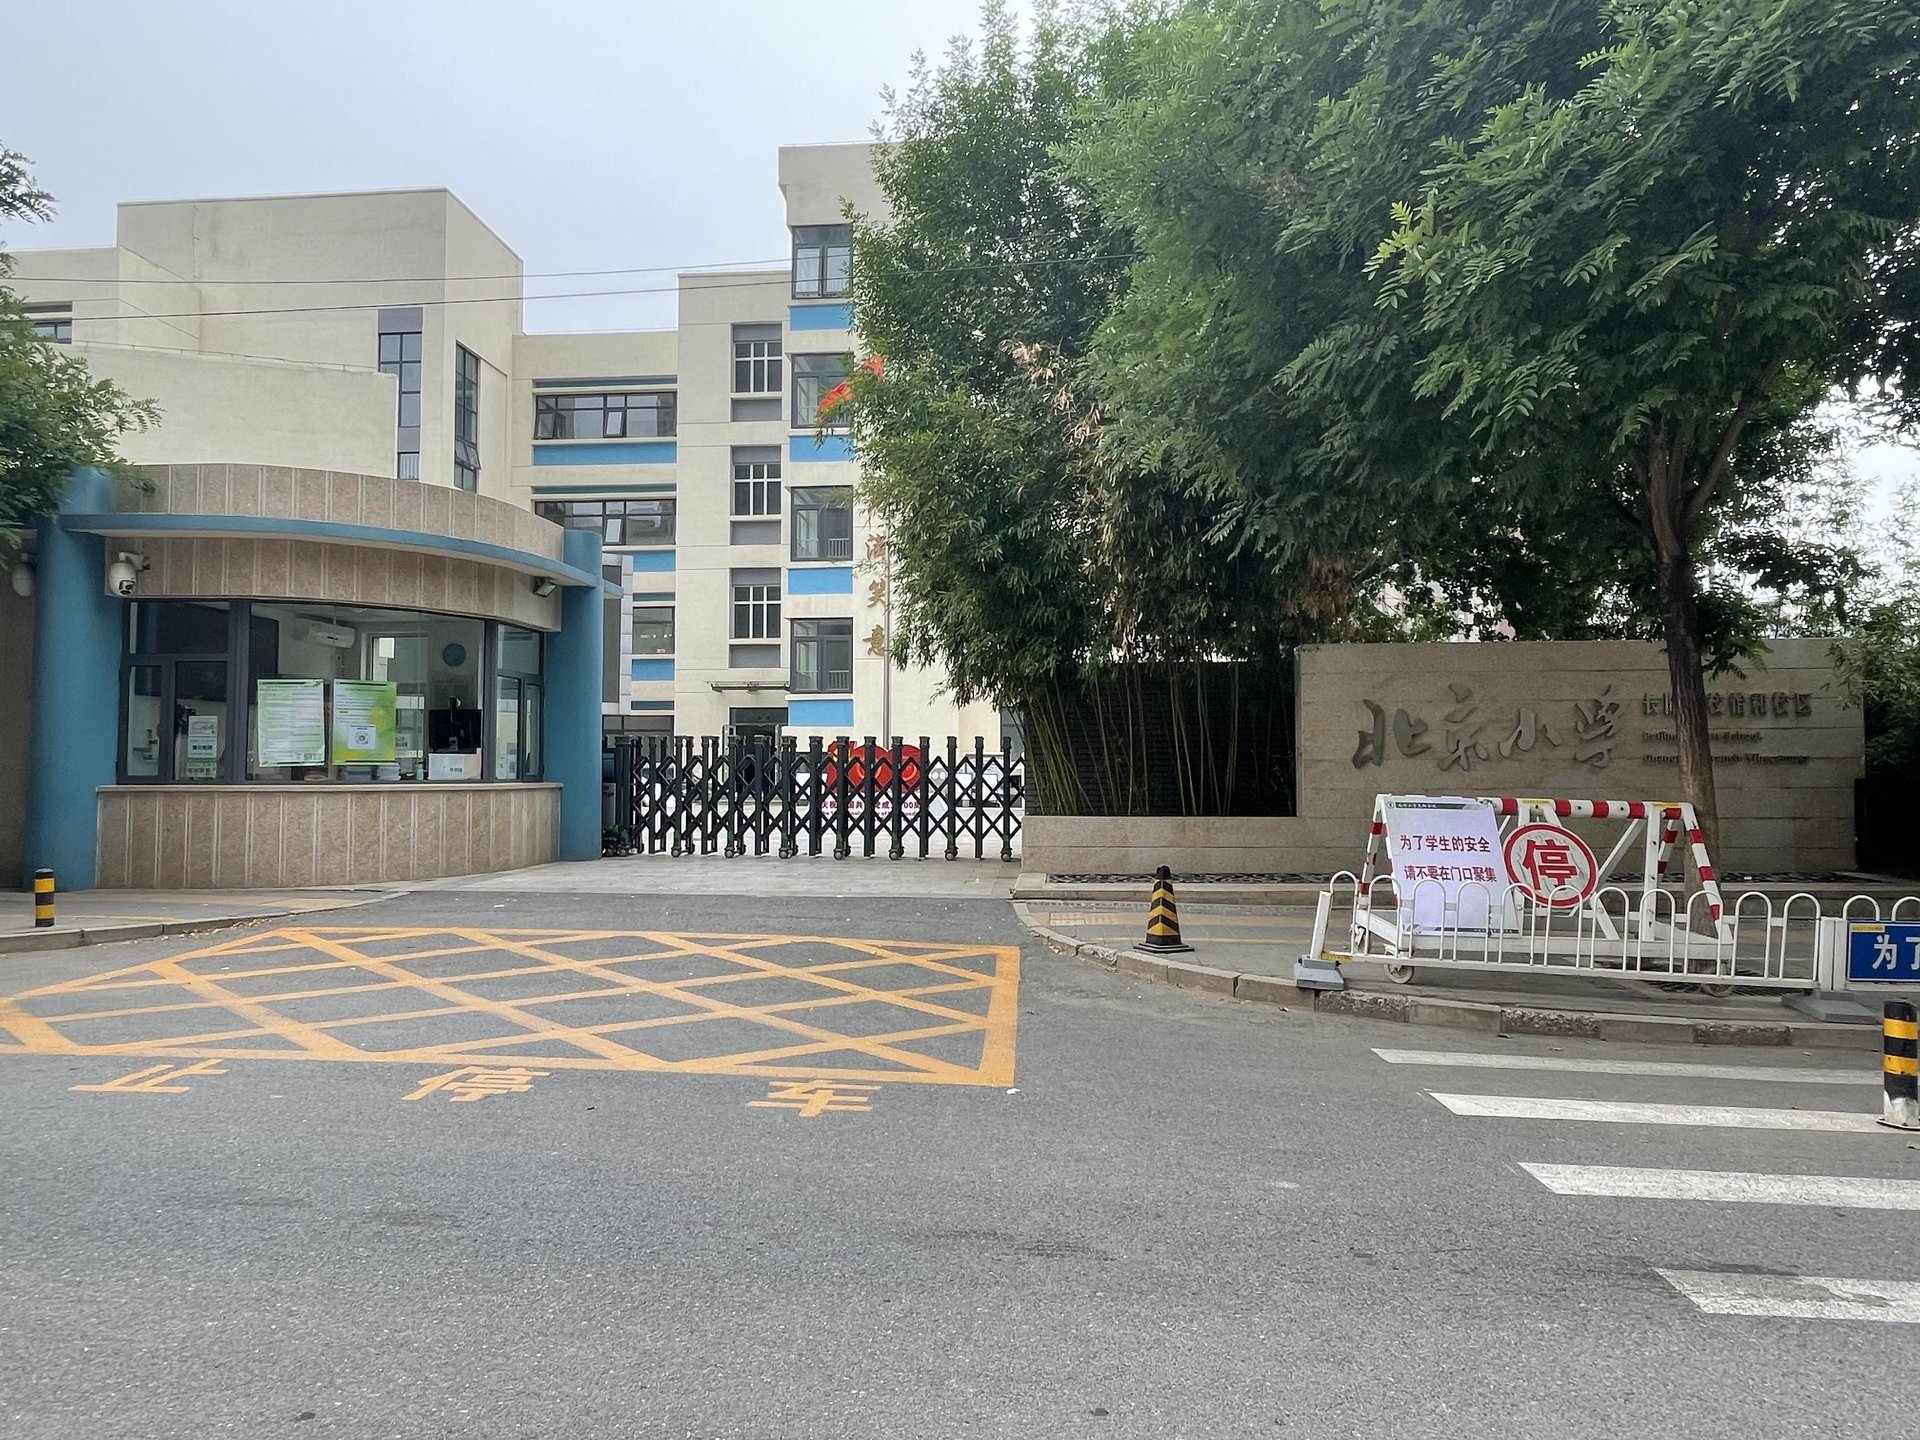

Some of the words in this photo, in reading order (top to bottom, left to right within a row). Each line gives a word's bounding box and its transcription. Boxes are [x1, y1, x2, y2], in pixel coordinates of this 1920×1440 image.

[1352, 683, 1622, 770] 北京小学
[1400, 834, 1491, 853] 为了学生的安全
[1404, 865, 1498, 882] 请不要在门口聚集
[1522, 839, 1578, 891] 停
[1872, 934, 1920, 970] 为了
